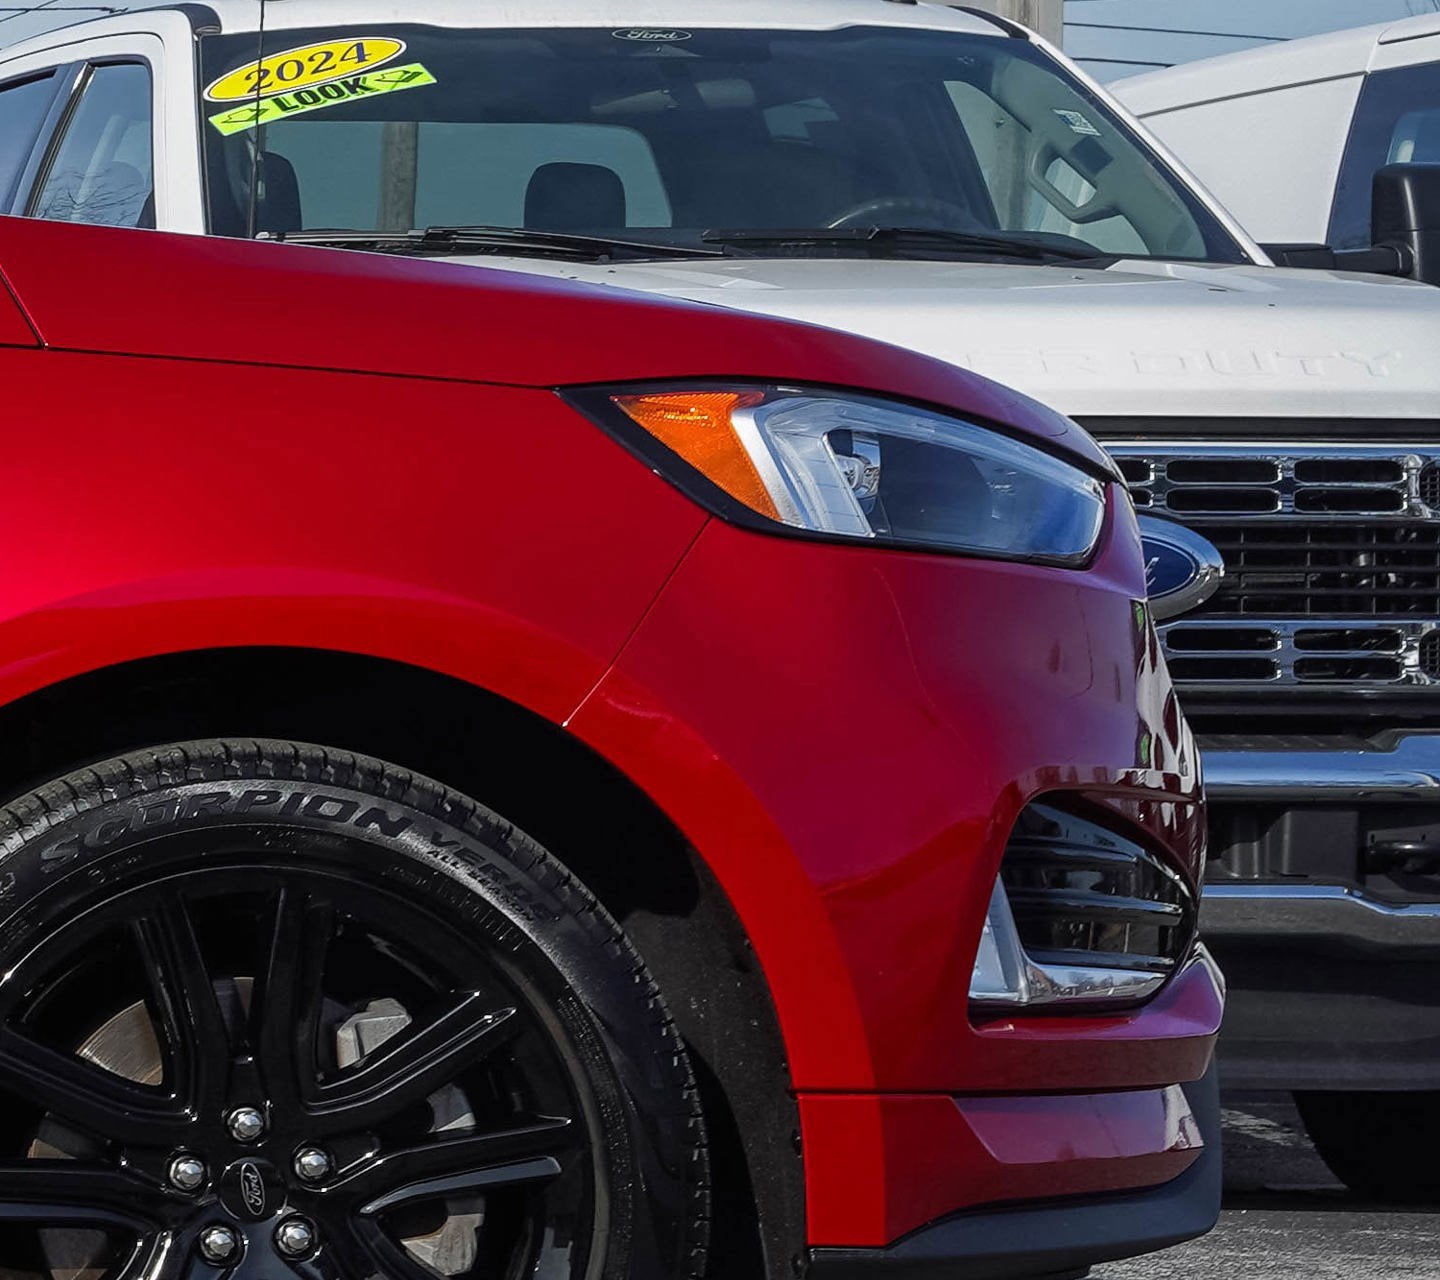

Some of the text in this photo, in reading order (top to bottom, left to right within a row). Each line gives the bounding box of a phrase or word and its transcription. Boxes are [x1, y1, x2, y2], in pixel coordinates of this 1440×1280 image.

[626, 29, 679, 39] Ford
[244, 41, 373, 94] 2024
[273, 76, 375, 113] LOOK
[39, 786, 415, 874] SCORPION
